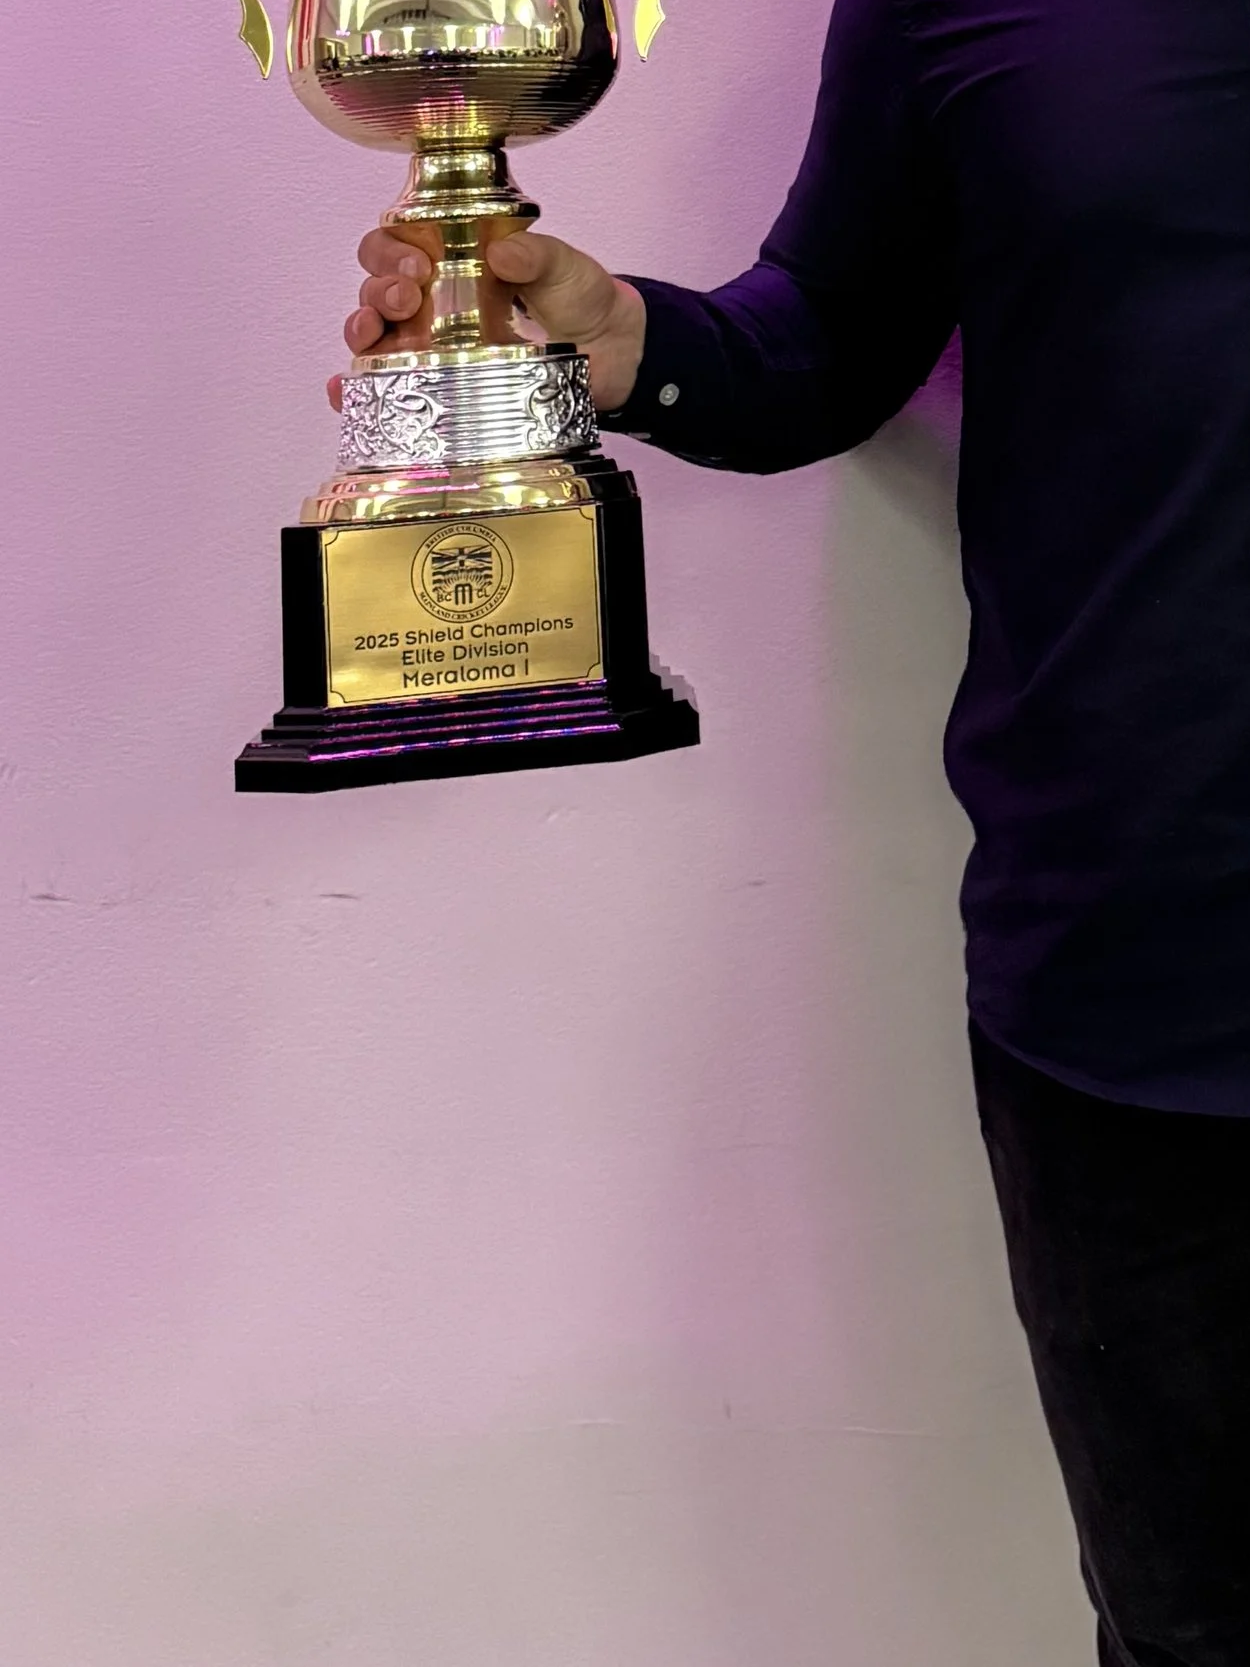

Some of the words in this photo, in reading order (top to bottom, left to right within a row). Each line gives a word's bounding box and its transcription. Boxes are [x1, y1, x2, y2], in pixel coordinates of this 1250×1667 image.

[354, 633, 400, 651] 2025
[405, 626, 464, 646] Shield
[470, 617, 574, 638] Champions
[402, 649, 445, 666] Elite
[453, 641, 529, 661] Division
[403, 663, 515, 689] Meraloma
